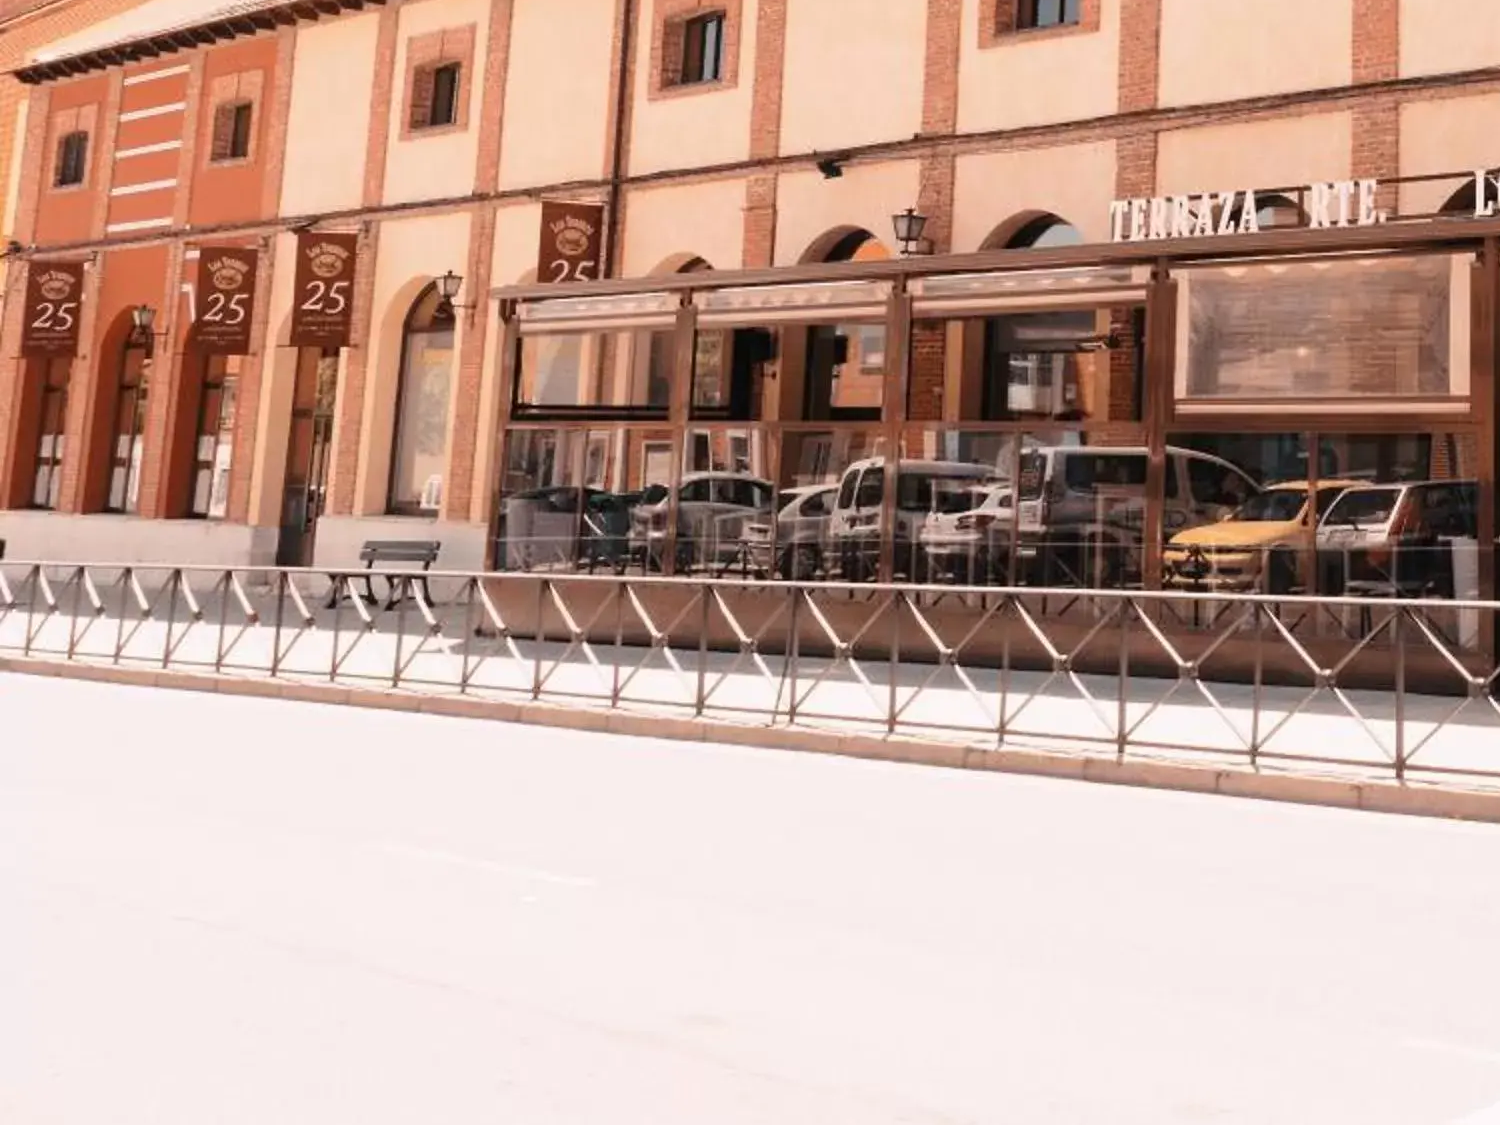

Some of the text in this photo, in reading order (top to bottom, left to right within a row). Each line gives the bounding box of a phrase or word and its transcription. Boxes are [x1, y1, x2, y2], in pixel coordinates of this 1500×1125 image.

[1110, 178, 1388, 243] TERRAZA RTE.
[550, 259, 595, 283] 25
[202, 293, 249, 325] 25
[301, 280, 350, 314] 25
[31, 302, 78, 331] 25
